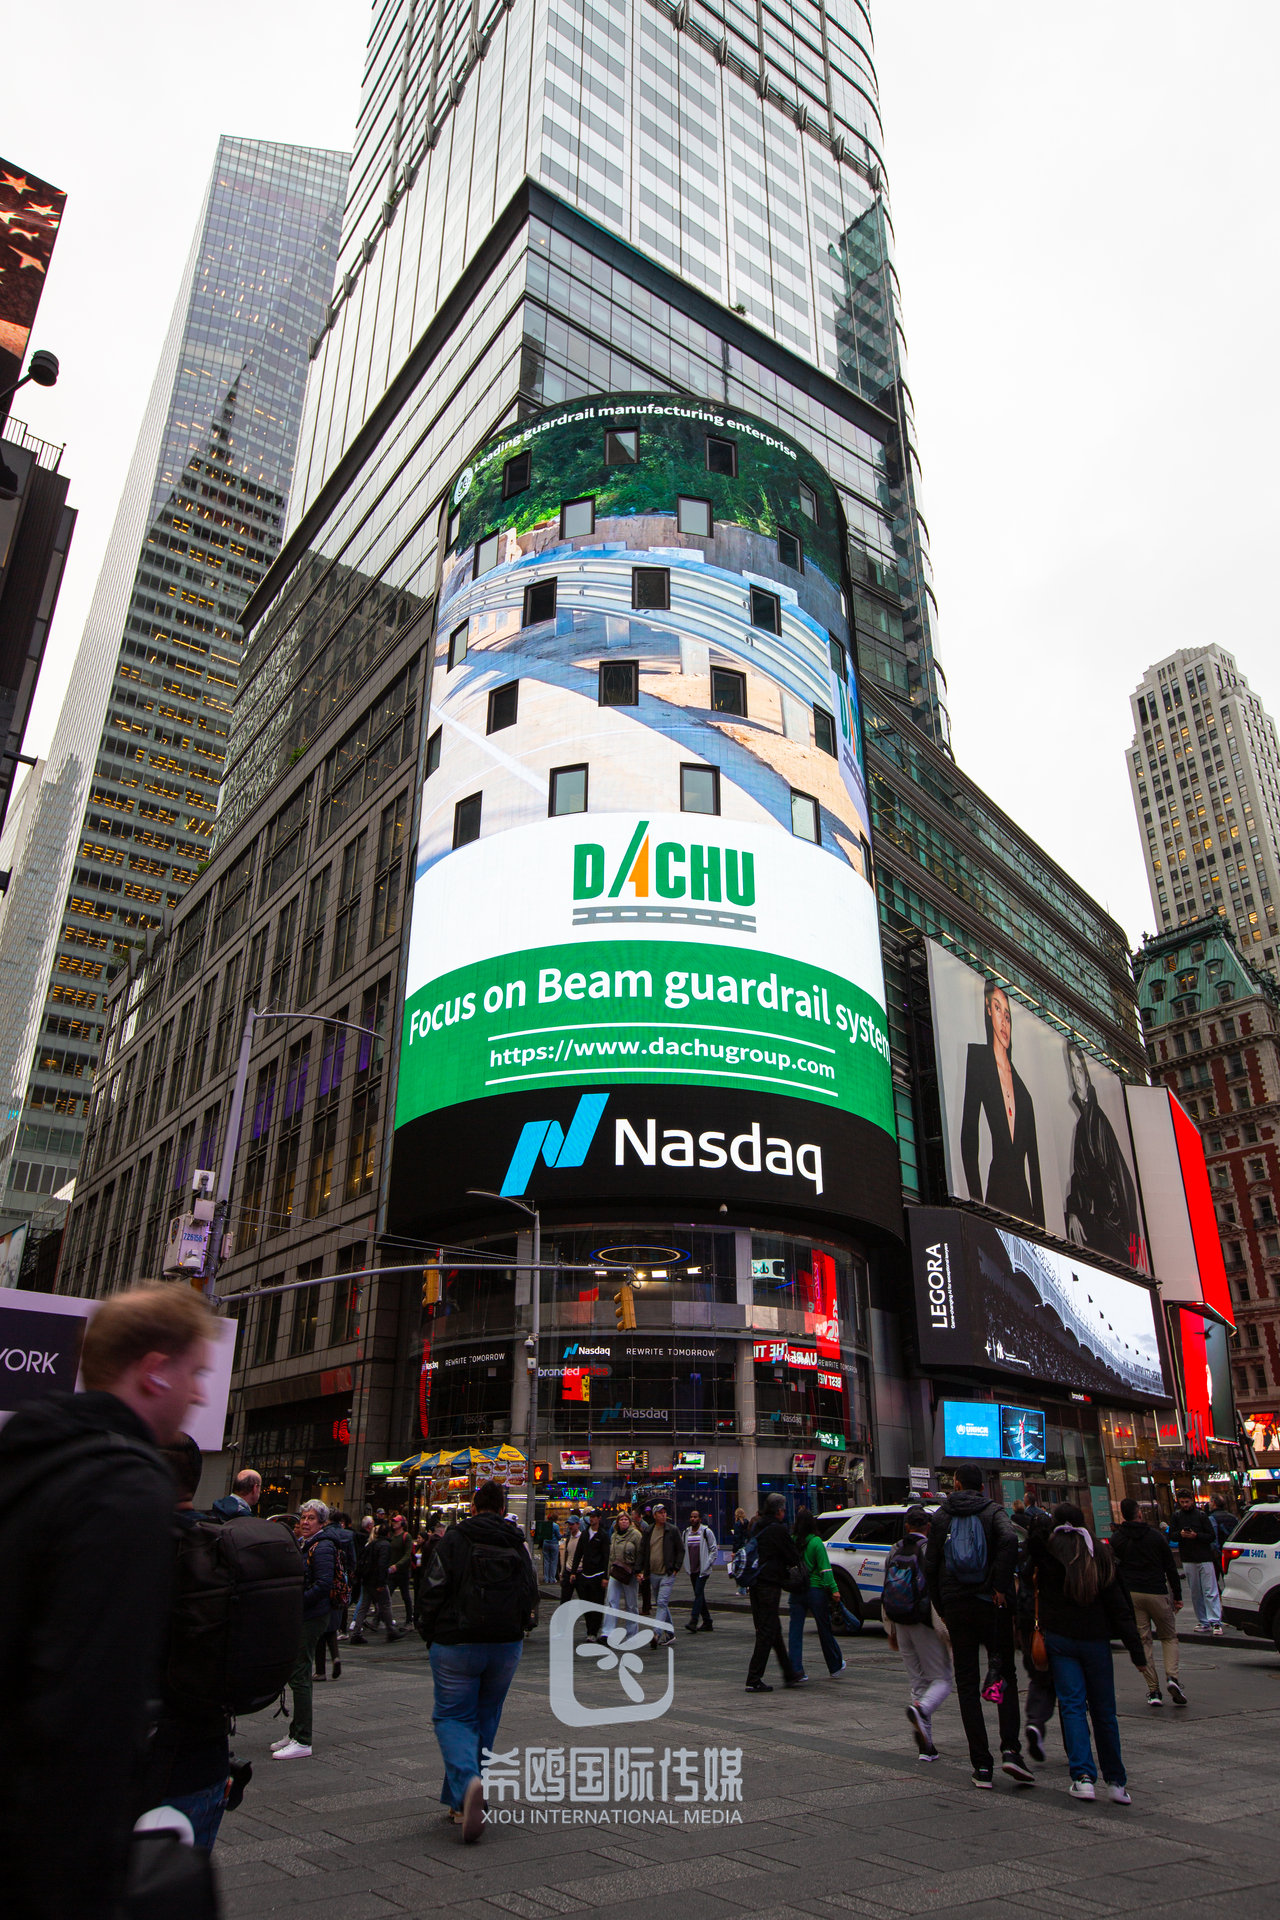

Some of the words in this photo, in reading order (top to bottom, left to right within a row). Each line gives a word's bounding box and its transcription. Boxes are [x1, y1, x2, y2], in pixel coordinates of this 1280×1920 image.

[474, 434, 521, 473] Leading
[523, 408, 595, 441] guardrail
[598, 404, 724, 427] manufacturing
[726, 419, 797, 461] enterprise
[573, 821, 756, 907] DACHU
[409, 991, 476, 1045] Focus
[483, 979, 526, 1013] on
[538, 968, 653, 1004] Beam
[664, 971, 831, 1025] guardrail
[835, 1003, 891, 1067] system
[490, 1037, 835, 1079] https://www.dachugroup.com
[615, 1118, 823, 1195] Nasdaq
[925, 1242, 949, 1328] LEGORA
[578, 1346, 611, 1356] Nasdaq
[626, 1347, 664, 1356] REWRITE
[668, 1348, 715, 1357] TOMORROW
